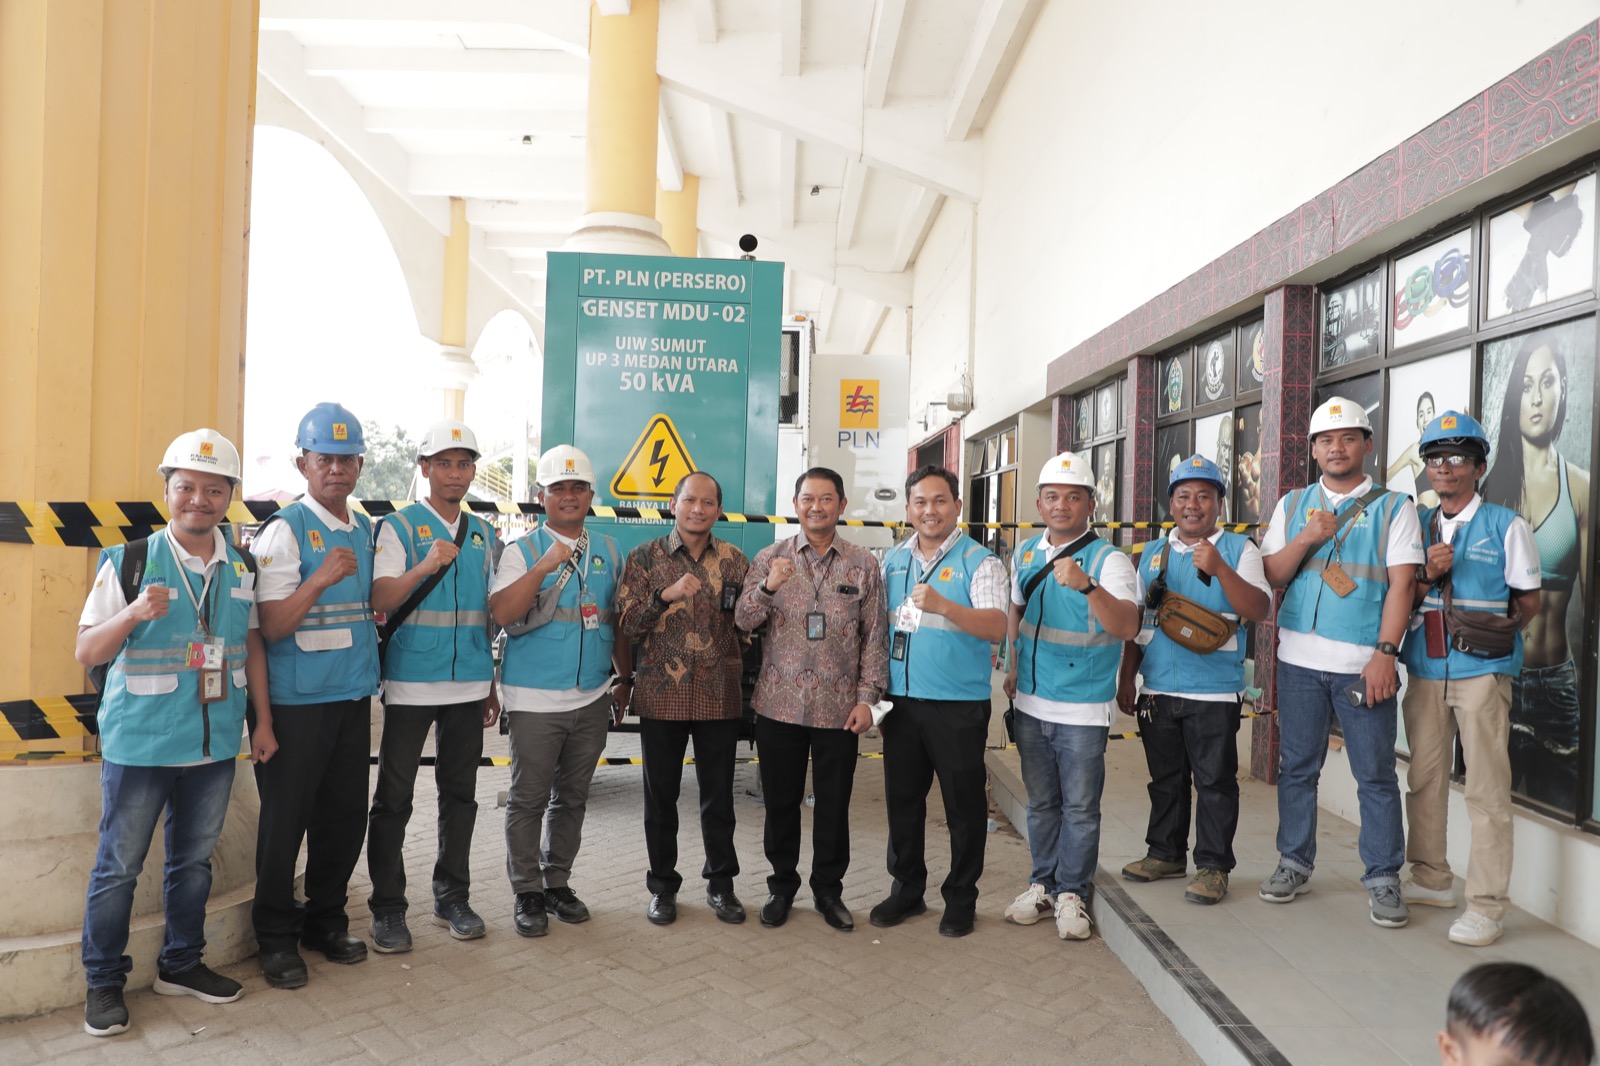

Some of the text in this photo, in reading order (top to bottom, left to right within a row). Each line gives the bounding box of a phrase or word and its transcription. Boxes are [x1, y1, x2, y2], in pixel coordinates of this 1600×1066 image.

[583, 268, 746, 293] PT. PLN (PERSERO)
[583, 299, 659, 319] GENSET
[662, 302, 709, 321] MDU
[721, 305, 746, 323] 02
[615, 335, 707, 353] UIW SUMUT
[585, 352, 739, 373] UP 3 MEDAN UTARA
[619, 371, 695, 393] 50 kVA
[838, 431, 880, 448] PLN
[619, 501, 659, 510] BAHAYA
[614, 517, 667, 525] TEGANGAN
[312, 545, 326, 553] PLN
[952, 571, 964, 579] PLN
